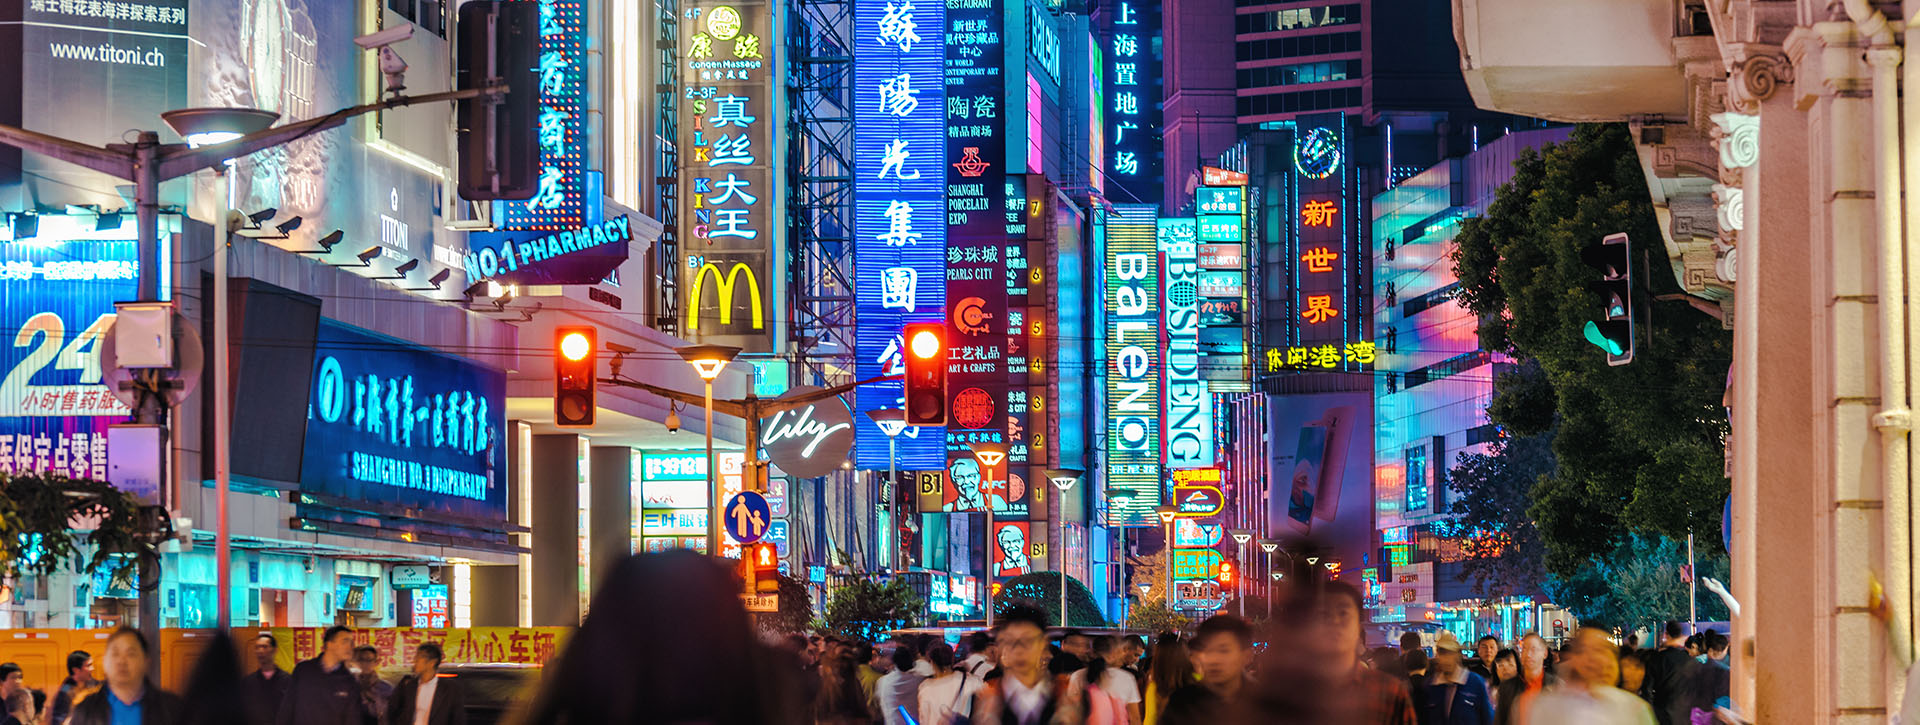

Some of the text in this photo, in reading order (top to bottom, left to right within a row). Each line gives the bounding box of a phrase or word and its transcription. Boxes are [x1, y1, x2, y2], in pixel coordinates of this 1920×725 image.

[685, 8, 702, 20] 4F
[953, 20, 987, 32] 新世界
[50, 43, 165, 66] www.titoni.ch
[960, 46, 982, 57] 中心
[723, 60, 761, 69] Massage
[685, 87, 717, 99] 2-3F
[1114, 2, 1139, 176] 上海置地广场
[947, 95, 996, 119] 陶瓷
[948, 125, 992, 138] 精品商场
[693, 99, 711, 239] SILK KING
[708, 93, 758, 240] 真丝大王
[948, 184, 984, 197] SHANGHAI
[948, 198, 989, 210] PORCELAIN
[1031, 201, 1040, 215] 7
[948, 213, 967, 225] EXPO
[380, 214, 409, 251] TITONI
[464, 216, 630, 284] NO.1 PHARMACY
[947, 246, 998, 263] 珍珠城
[688, 256, 705, 268] B1
[1301, 199, 1338, 324] 新世界
[947, 268, 992, 280] PEARLS CITY
[1032, 267, 1040, 280] 6
[1033, 322, 1041, 334] 5
[948, 346, 1000, 360] 工艺礼品
[1267, 341, 1376, 372] 休闲港湾
[948, 363, 995, 373] ART & CRAFTS
[1033, 358, 1041, 370] 4
[1033, 395, 1041, 409] 3
[1033, 433, 1042, 447] 2
[352, 451, 488, 501] SHANGHAI NO.1 DISPENSARY
[921, 473, 943, 494] B1
[1032, 544, 1045, 556] B1
